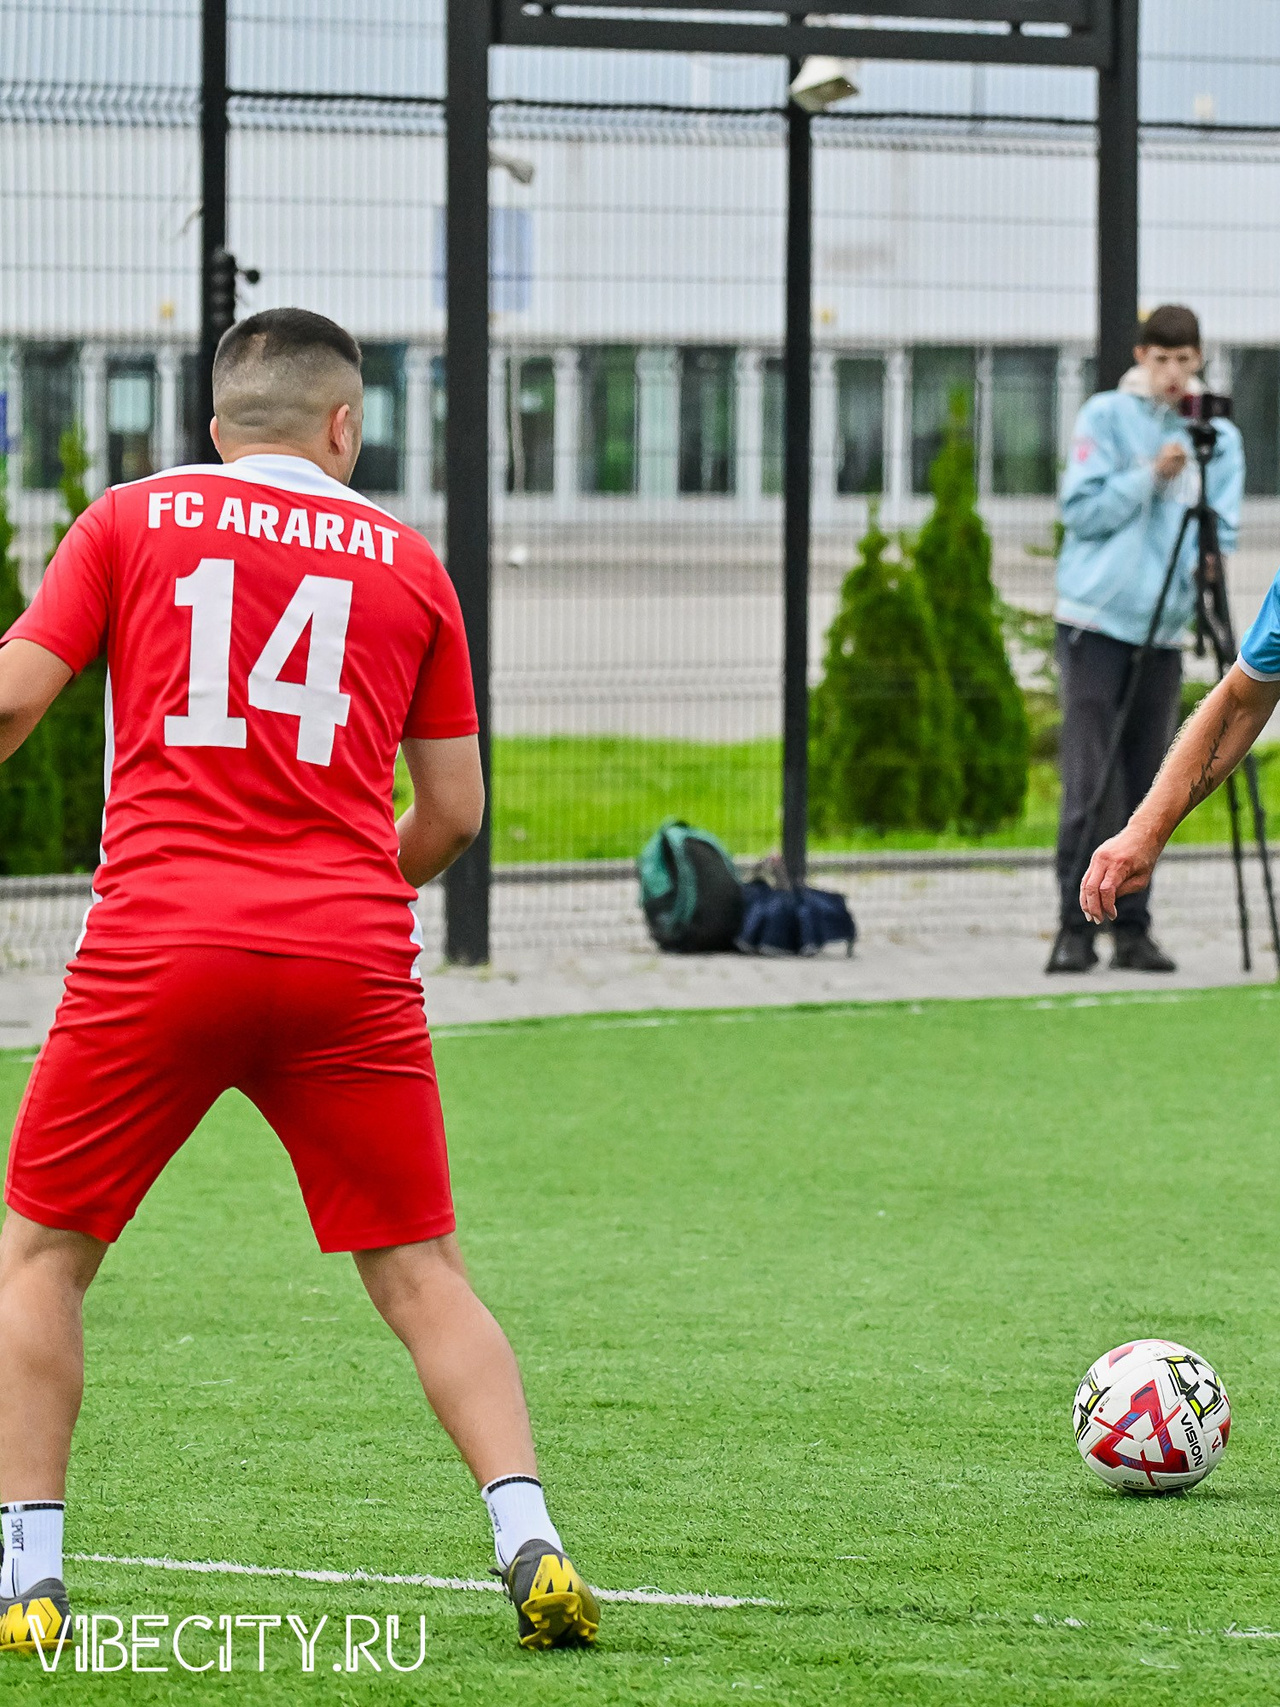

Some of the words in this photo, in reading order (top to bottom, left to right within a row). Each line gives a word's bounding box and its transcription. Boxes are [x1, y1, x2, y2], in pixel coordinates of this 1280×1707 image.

[148, 491, 204, 529] FC
[216, 497, 399, 566] ARARAT
[163, 557, 354, 767] 14
[1180, 1412, 1204, 1468] VISION
